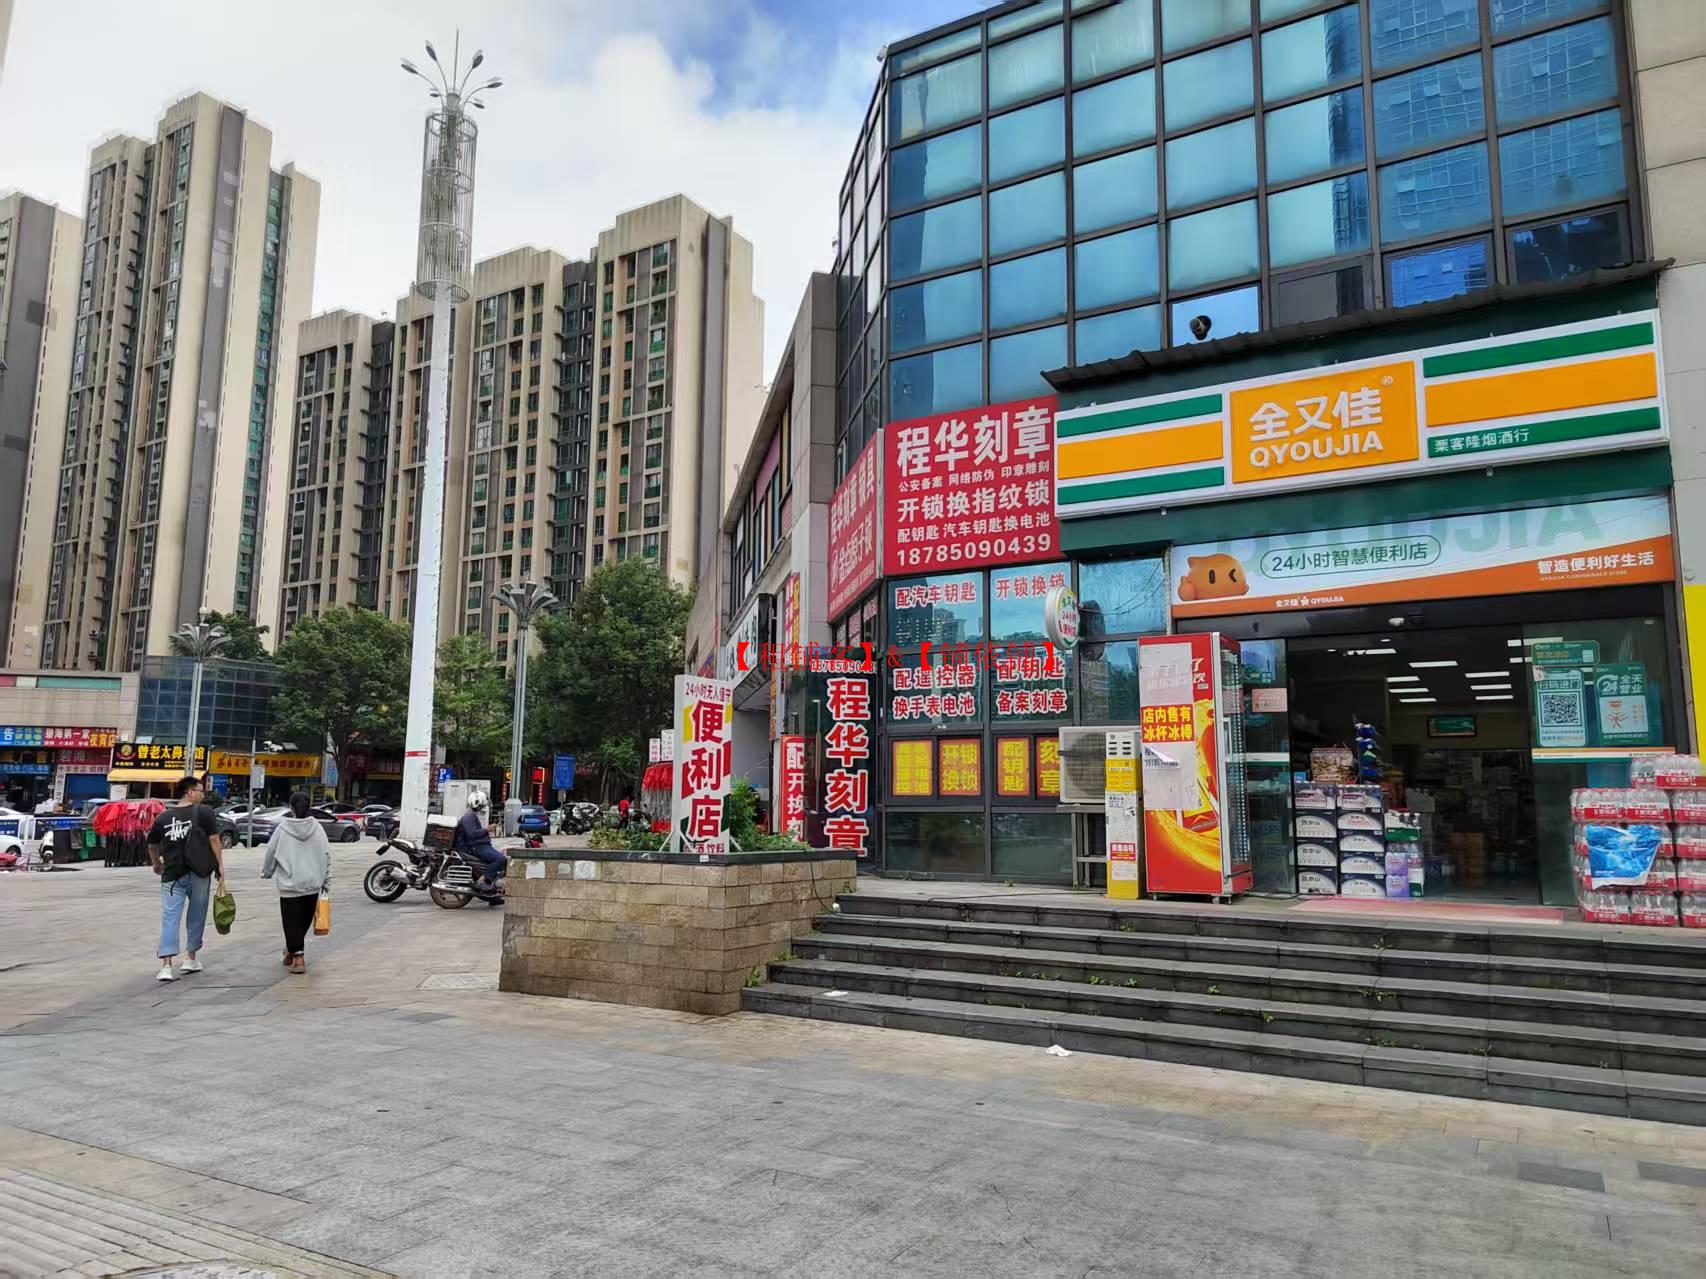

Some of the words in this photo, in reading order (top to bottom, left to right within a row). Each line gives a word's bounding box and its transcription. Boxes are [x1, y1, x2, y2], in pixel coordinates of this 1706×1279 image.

[1249, 386, 1383, 441] 全又佳
[896, 405, 1052, 477] 程华刻章
[1250, 430, 1383, 468] QYOUJIA
[899, 476, 943, 493] 公安备案
[949, 469, 995, 486] 网络防伪
[1001, 460, 1050, 478] 印章雕刻
[897, 479, 1050, 523] 开锁换指纹锁
[897, 525, 939, 543] 配钥匙
[943, 511, 1050, 538] 汽车钥匙换电池
[897, 533, 1051, 566] 18785090439
[1271, 543, 1428, 572] 24小时智慧便利店
[1537, 551, 1655, 574] 智造便利好生活
[896, 581, 976, 608] 配汽车钥匙
[894, 664, 976, 690] 配遥控器
[997, 657, 1066, 682] 配钥匙
[1620, 674, 1643, 684] 全天
[996, 689, 1067, 714] 备案刻章
[1602, 682, 1618, 694] 24
[1620, 684, 1643, 694] 营业
[893, 692, 976, 719] 换手表电池
[1143, 706, 1191, 723] 店内售有
[824, 677, 871, 857] 程华刻章
[943, 743, 977, 765] 开锁
[1003, 742, 1025, 791] 配钥匙
[439, 769, 447, 780] P
[689, 701, 724, 838] 便利店
[943, 769, 977, 791] 换锁
